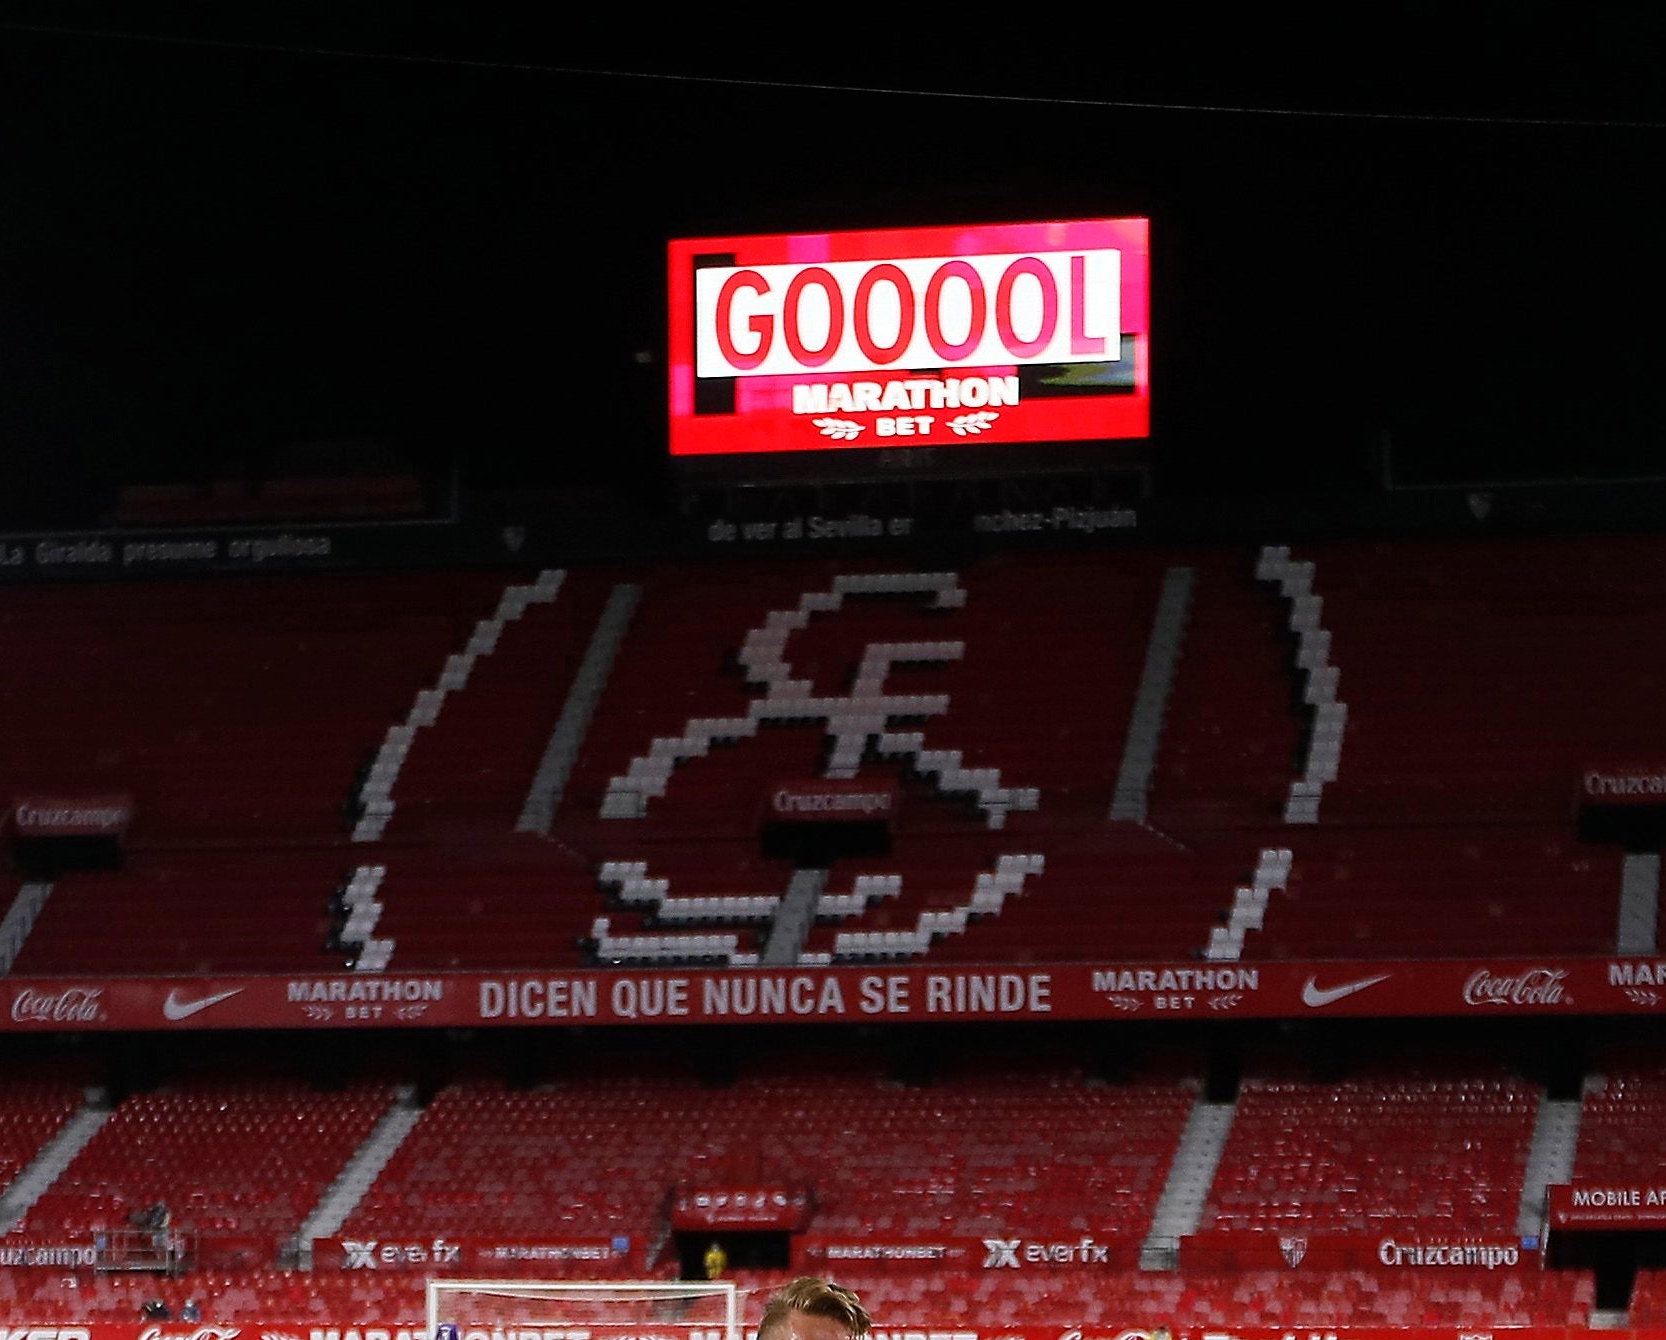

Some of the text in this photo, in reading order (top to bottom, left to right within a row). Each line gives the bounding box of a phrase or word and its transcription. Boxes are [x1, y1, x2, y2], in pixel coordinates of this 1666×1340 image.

[716, 256, 1106, 370] GOOOOL
[792, 376, 1020, 414] MARATHON
[876, 416, 935, 437] BET
[707, 520, 737, 541] de
[743, 523, 776, 540] ver
[808, 516, 882, 539] Sevilla
[287, 980, 443, 1001] MARATHON
[1092, 969, 1259, 992] MARATHON
[479, 975, 1052, 1019] DICEN QUE NUNCA SE RINDE
[1154, 996, 1195, 1010] BET
[345, 1006, 383, 1019] BET
[1573, 1190, 1641, 1207] MOBILE
[1026, 1240, 1109, 1262] everfx
[1380, 1240, 1519, 1269] Cruzcampo
